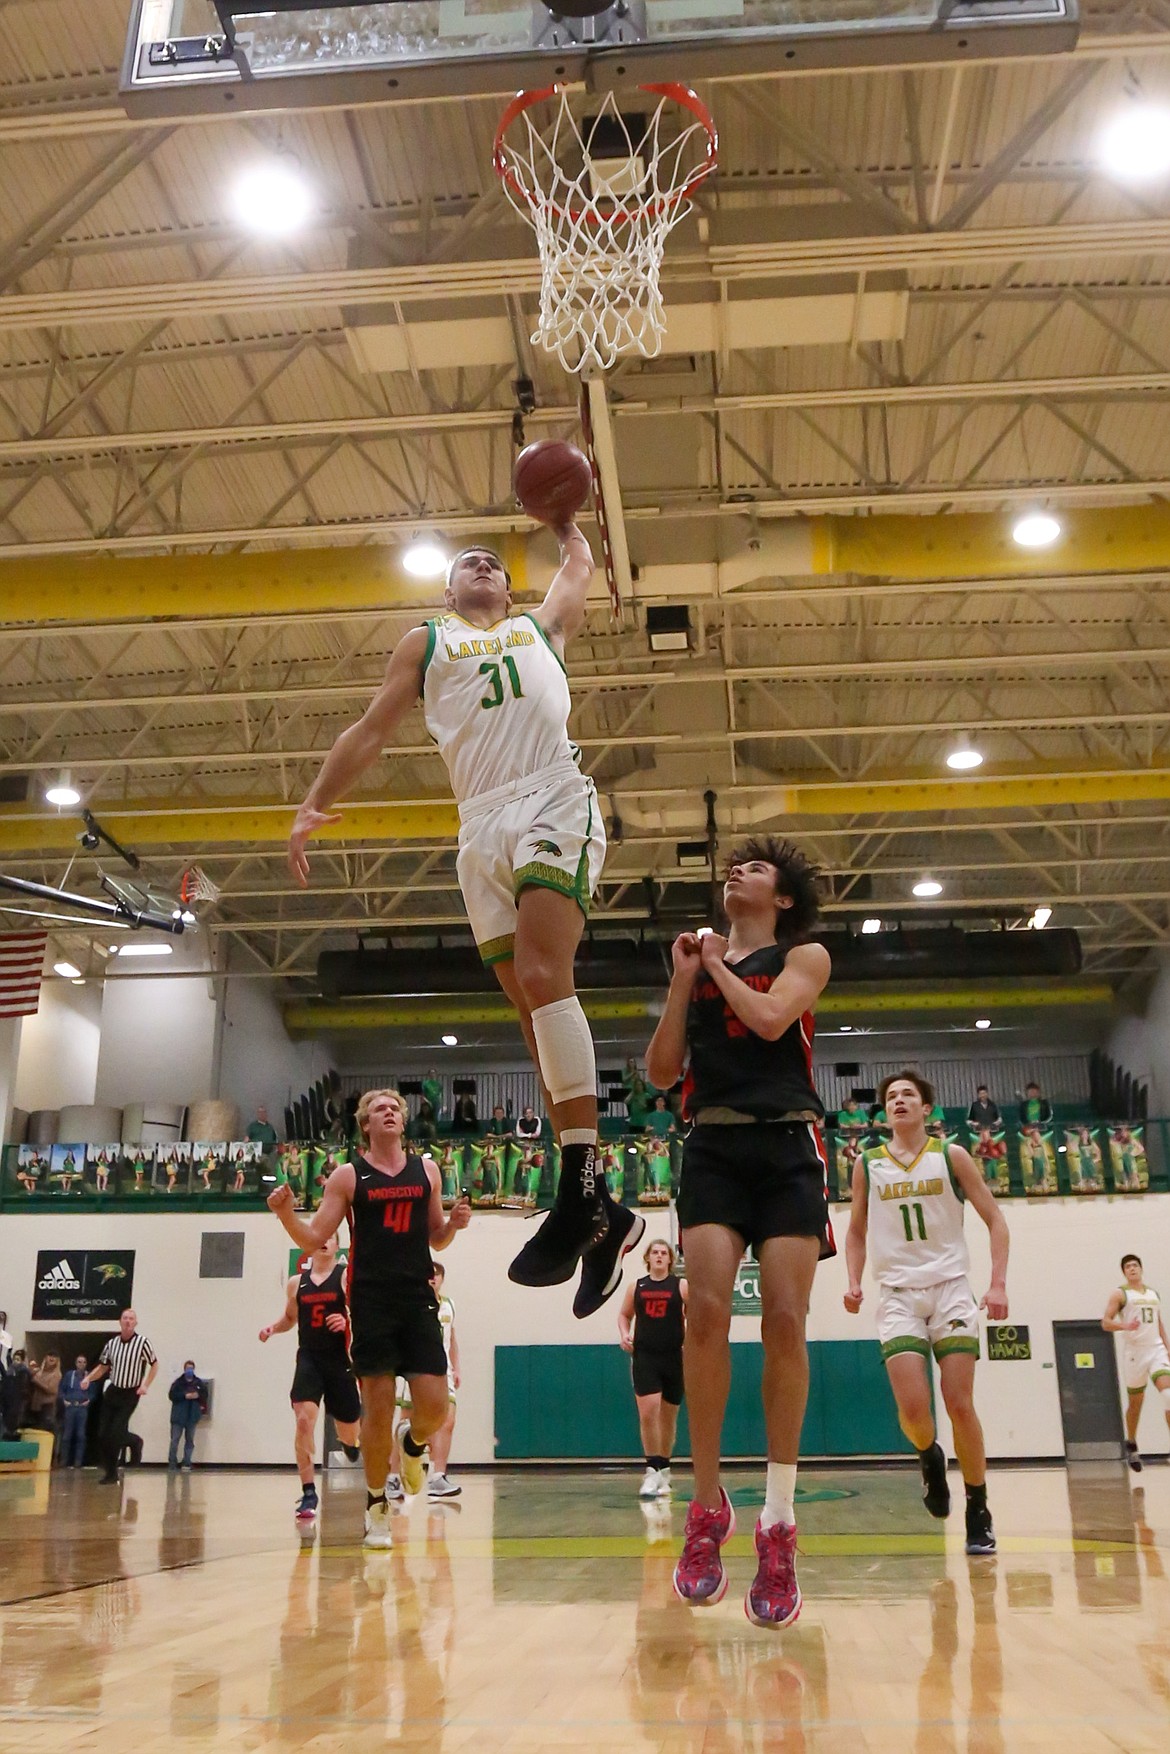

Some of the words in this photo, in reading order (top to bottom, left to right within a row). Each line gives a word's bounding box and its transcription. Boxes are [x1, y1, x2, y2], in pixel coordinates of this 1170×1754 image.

[479, 655, 525, 709] 31
[367, 1185, 424, 1201] MOSCOW
[877, 1178, 944, 1201] LAKELAND
[383, 1201, 413, 1233] 41
[899, 1203, 928, 1241] 11
[38, 1280, 80, 1290] adidas
[311, 1304, 325, 1328] 5
[645, 1300, 668, 1318] 43
[1141, 1307, 1154, 1324] 13
[995, 1326, 1018, 1341] GO
[989, 1343, 1030, 1359] HAWKS
